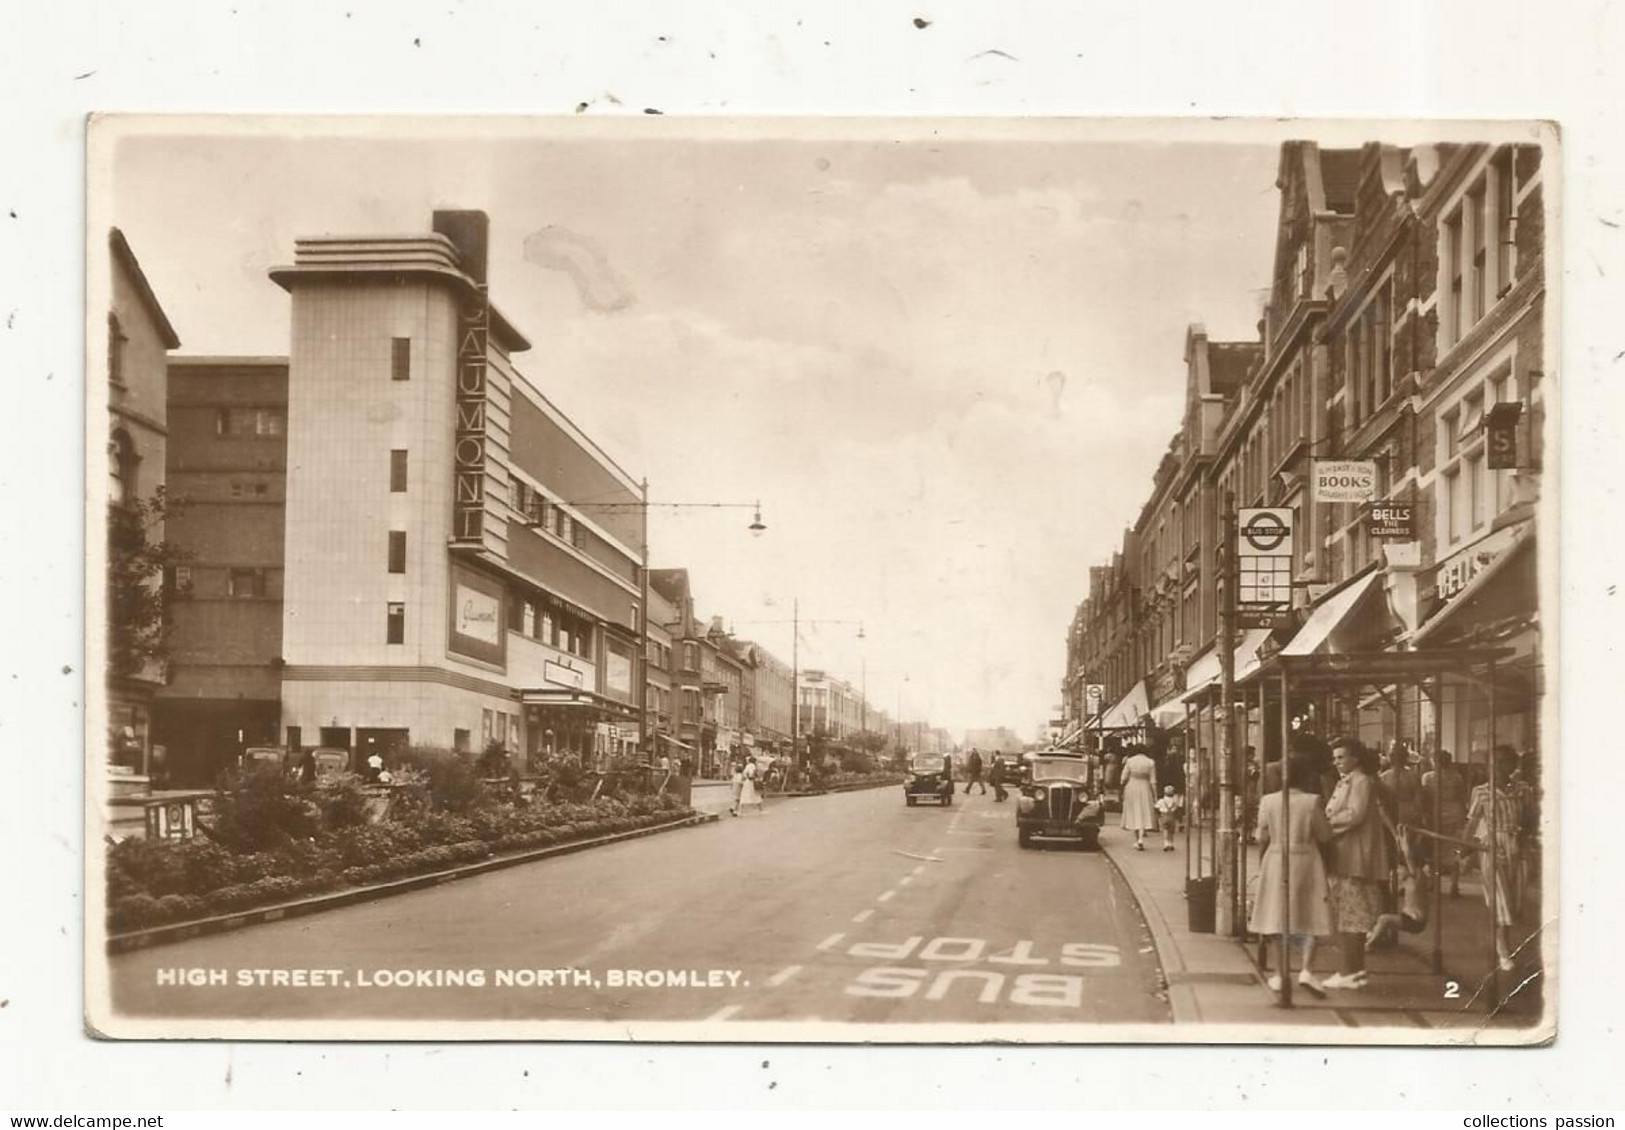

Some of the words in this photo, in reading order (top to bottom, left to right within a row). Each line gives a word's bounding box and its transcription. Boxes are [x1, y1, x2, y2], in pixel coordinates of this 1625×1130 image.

[1319, 477, 1372, 488] BOOKS
[1372, 509, 1411, 521] BELLS
[1383, 520, 1399, 528] THE
[1260, 576, 1270, 584] 47
[1258, 618, 1272, 628] 47
[847, 936, 1121, 967] STOP
[845, 966, 1084, 1008] BUS
